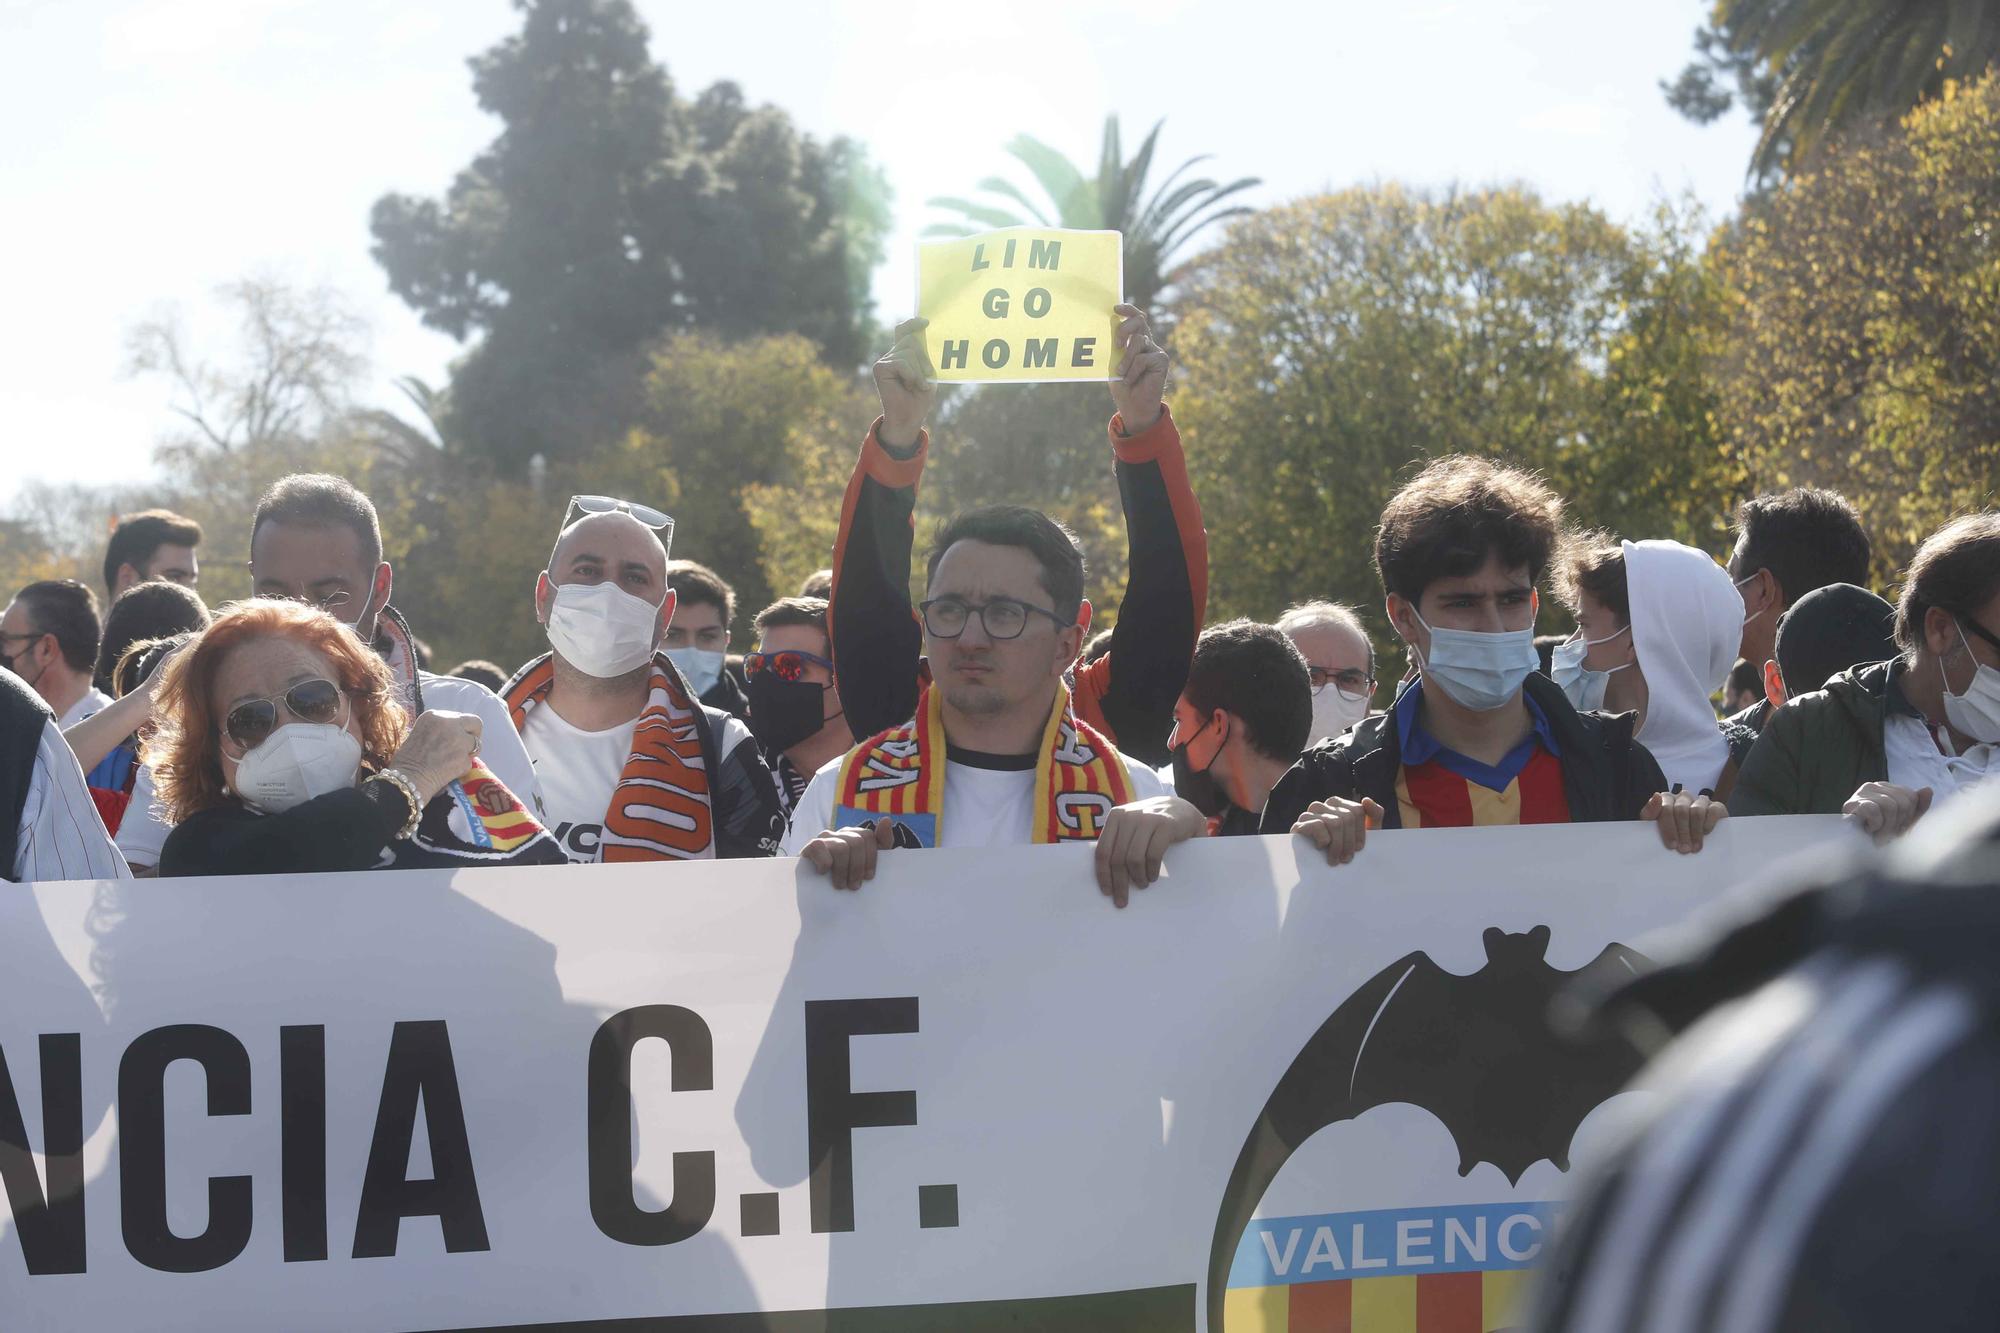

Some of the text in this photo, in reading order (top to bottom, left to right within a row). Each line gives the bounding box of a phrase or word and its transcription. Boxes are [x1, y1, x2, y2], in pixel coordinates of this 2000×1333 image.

[971, 239, 1062, 272] LIM
[982, 288, 1052, 319] GO
[941, 337, 1097, 369] HOME
[857, 720, 920, 792] VA
[757, 836, 779, 853] SA
[588, 996, 959, 1246] C.F.
[1259, 1213, 1548, 1277] VALENC
